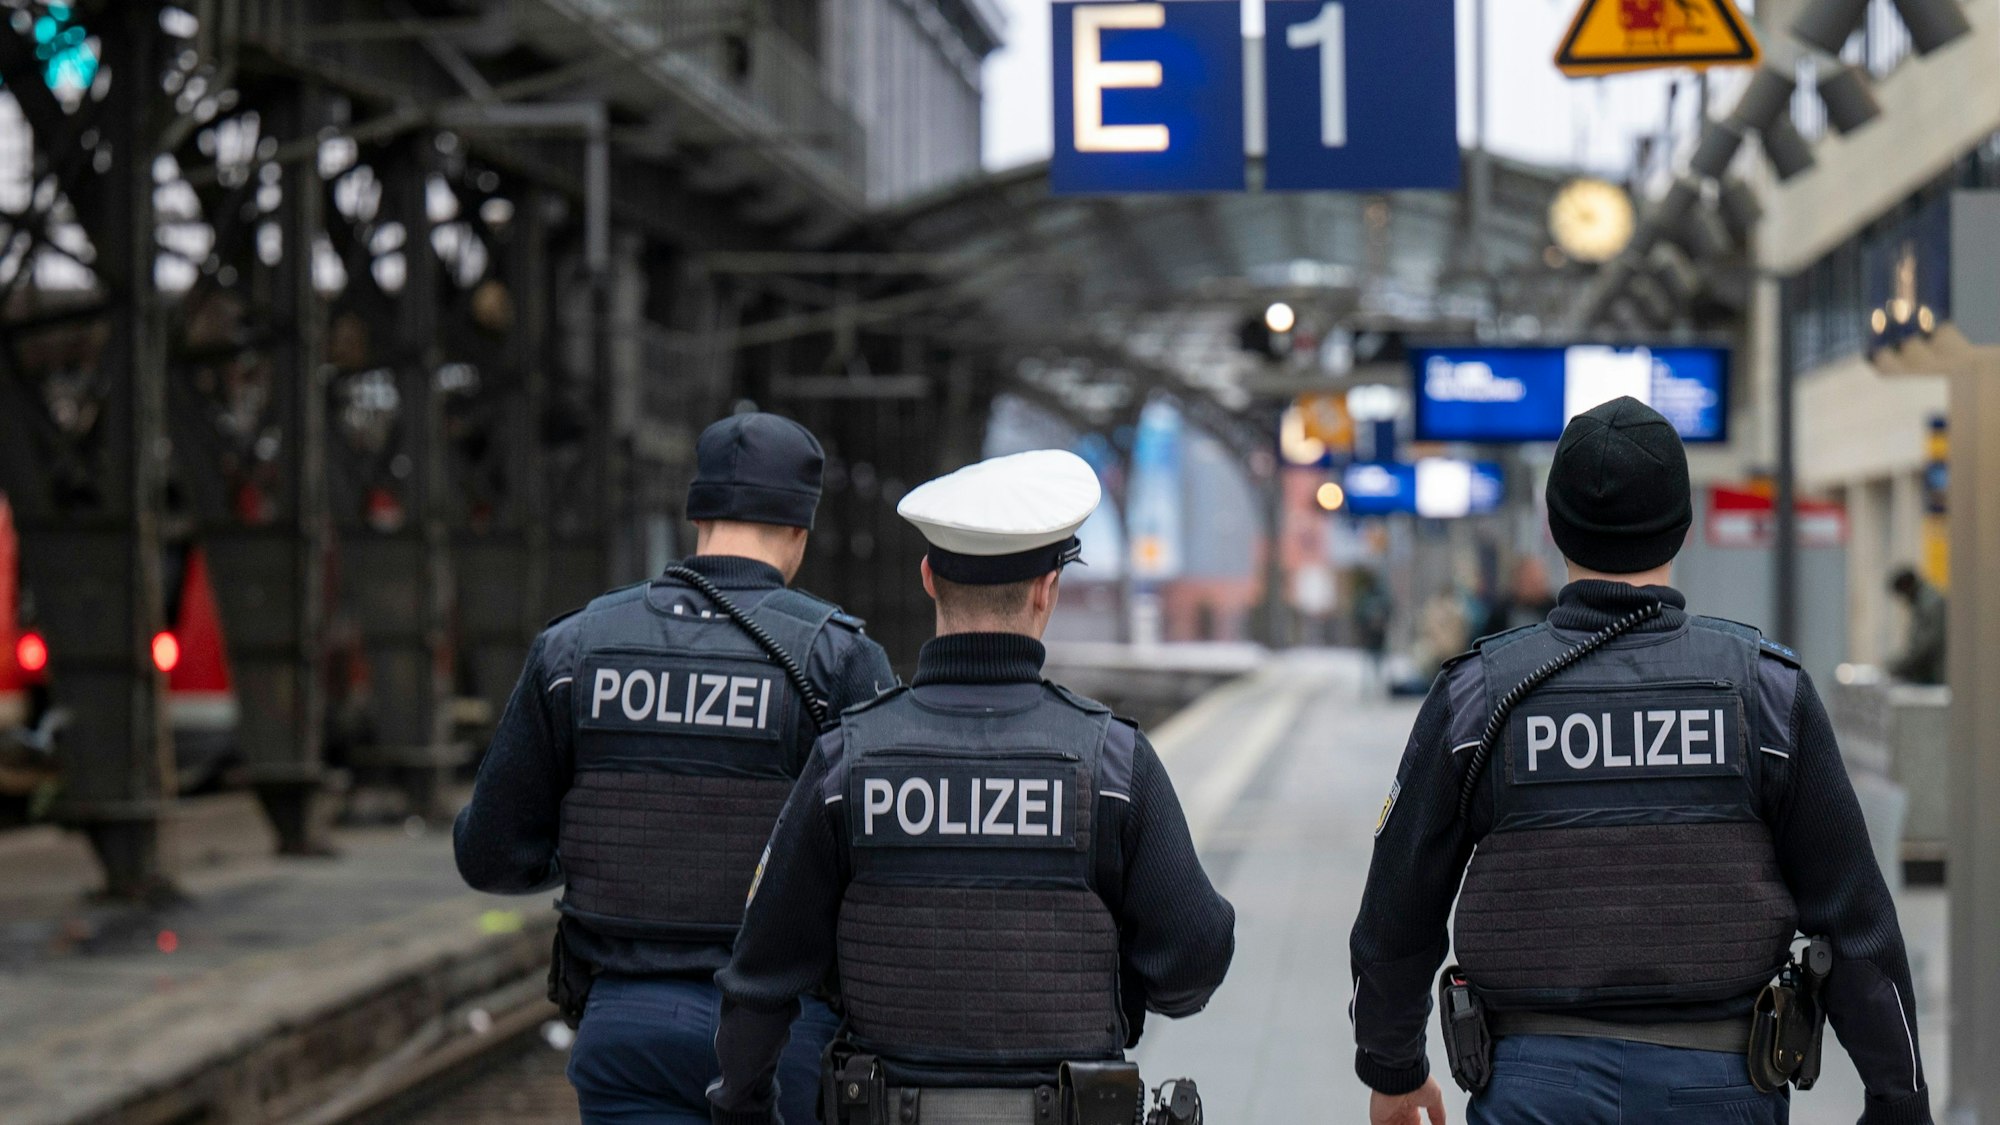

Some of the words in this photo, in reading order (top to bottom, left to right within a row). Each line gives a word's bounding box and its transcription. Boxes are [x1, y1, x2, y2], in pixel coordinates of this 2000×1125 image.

[1073, 4, 1169, 152] E
[1286, 3, 1347, 148] 1
[591, 668, 771, 729] POLIZEI
[1527, 709, 1725, 771] POLIZEI
[864, 777, 1063, 836] POLIZEI
